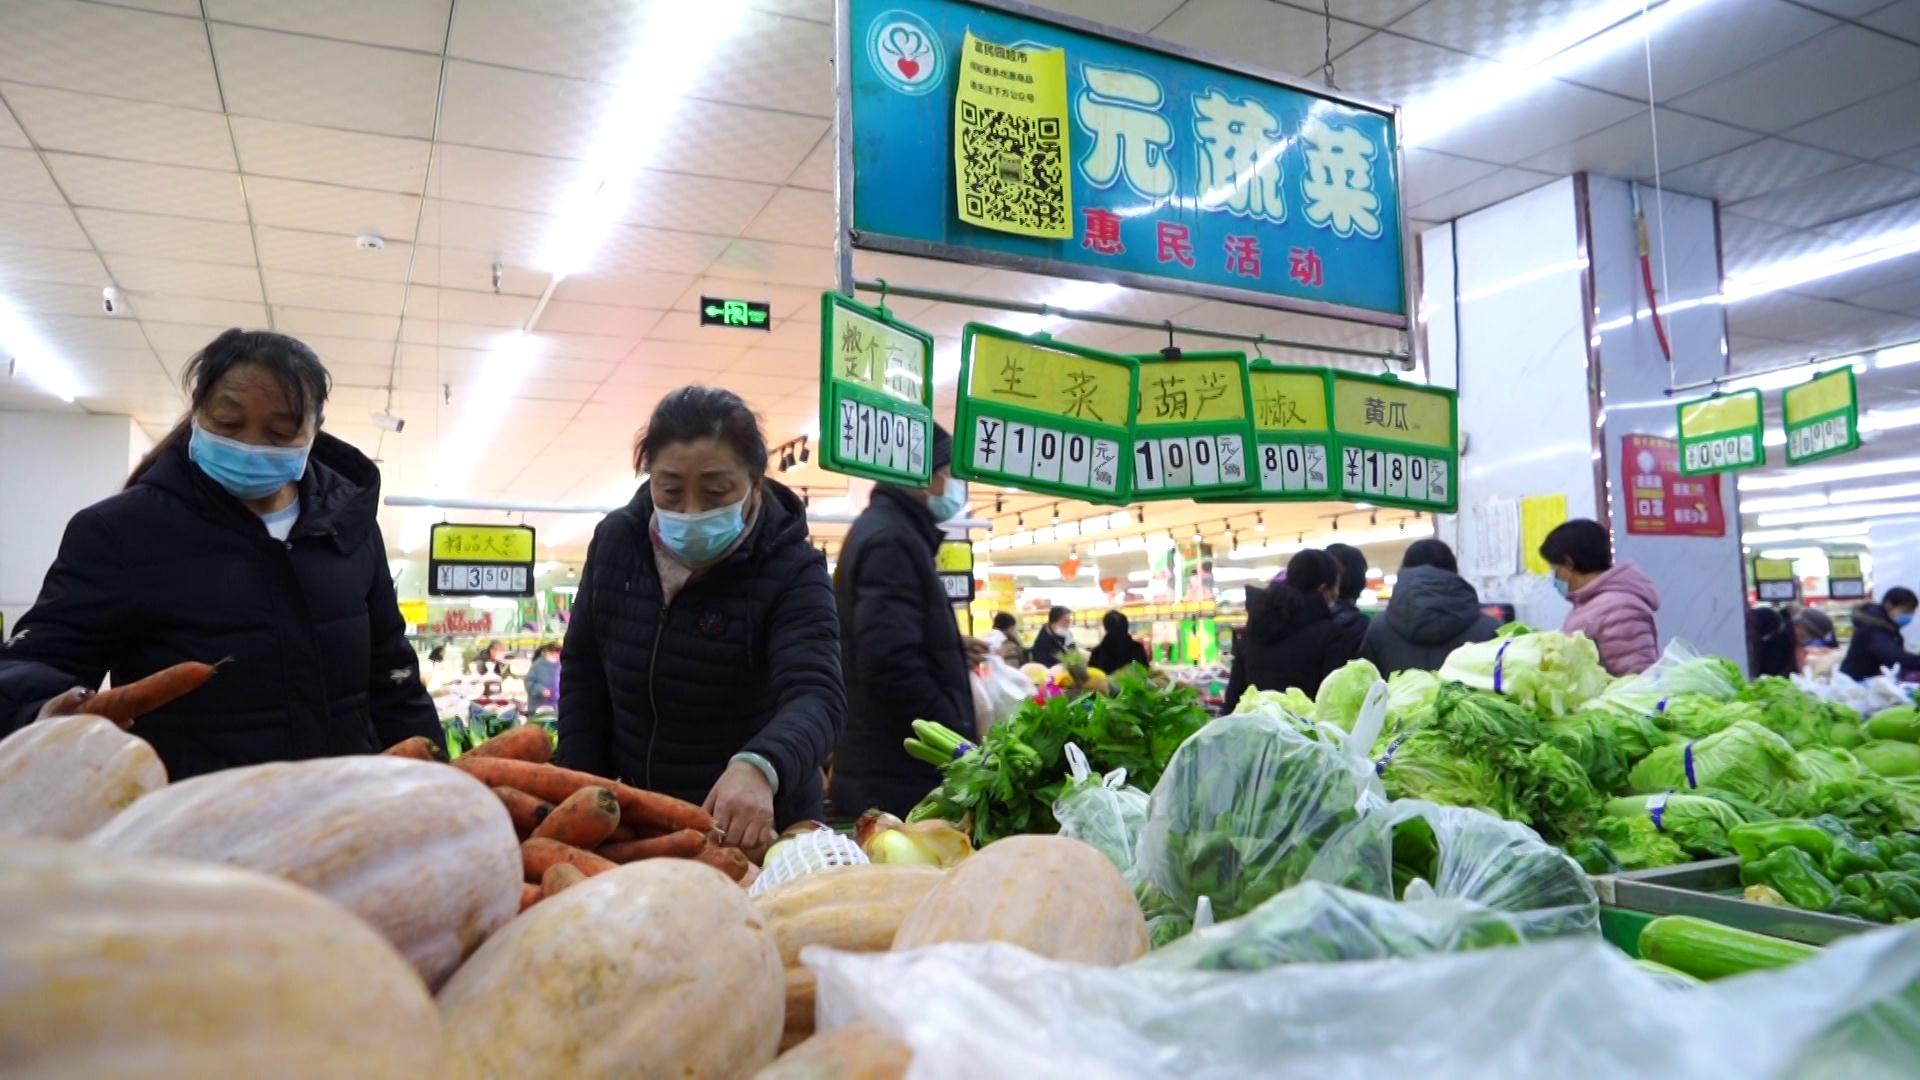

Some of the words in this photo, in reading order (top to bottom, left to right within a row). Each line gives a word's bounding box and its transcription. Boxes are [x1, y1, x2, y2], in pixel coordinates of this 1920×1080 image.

[1076, 61, 1383, 239] 元蔬菜
[1081, 207, 1325, 287] 惠民活动
[1137, 372, 1228, 420] 葫芦
[1364, 396, 1410, 431] 黄瓜
